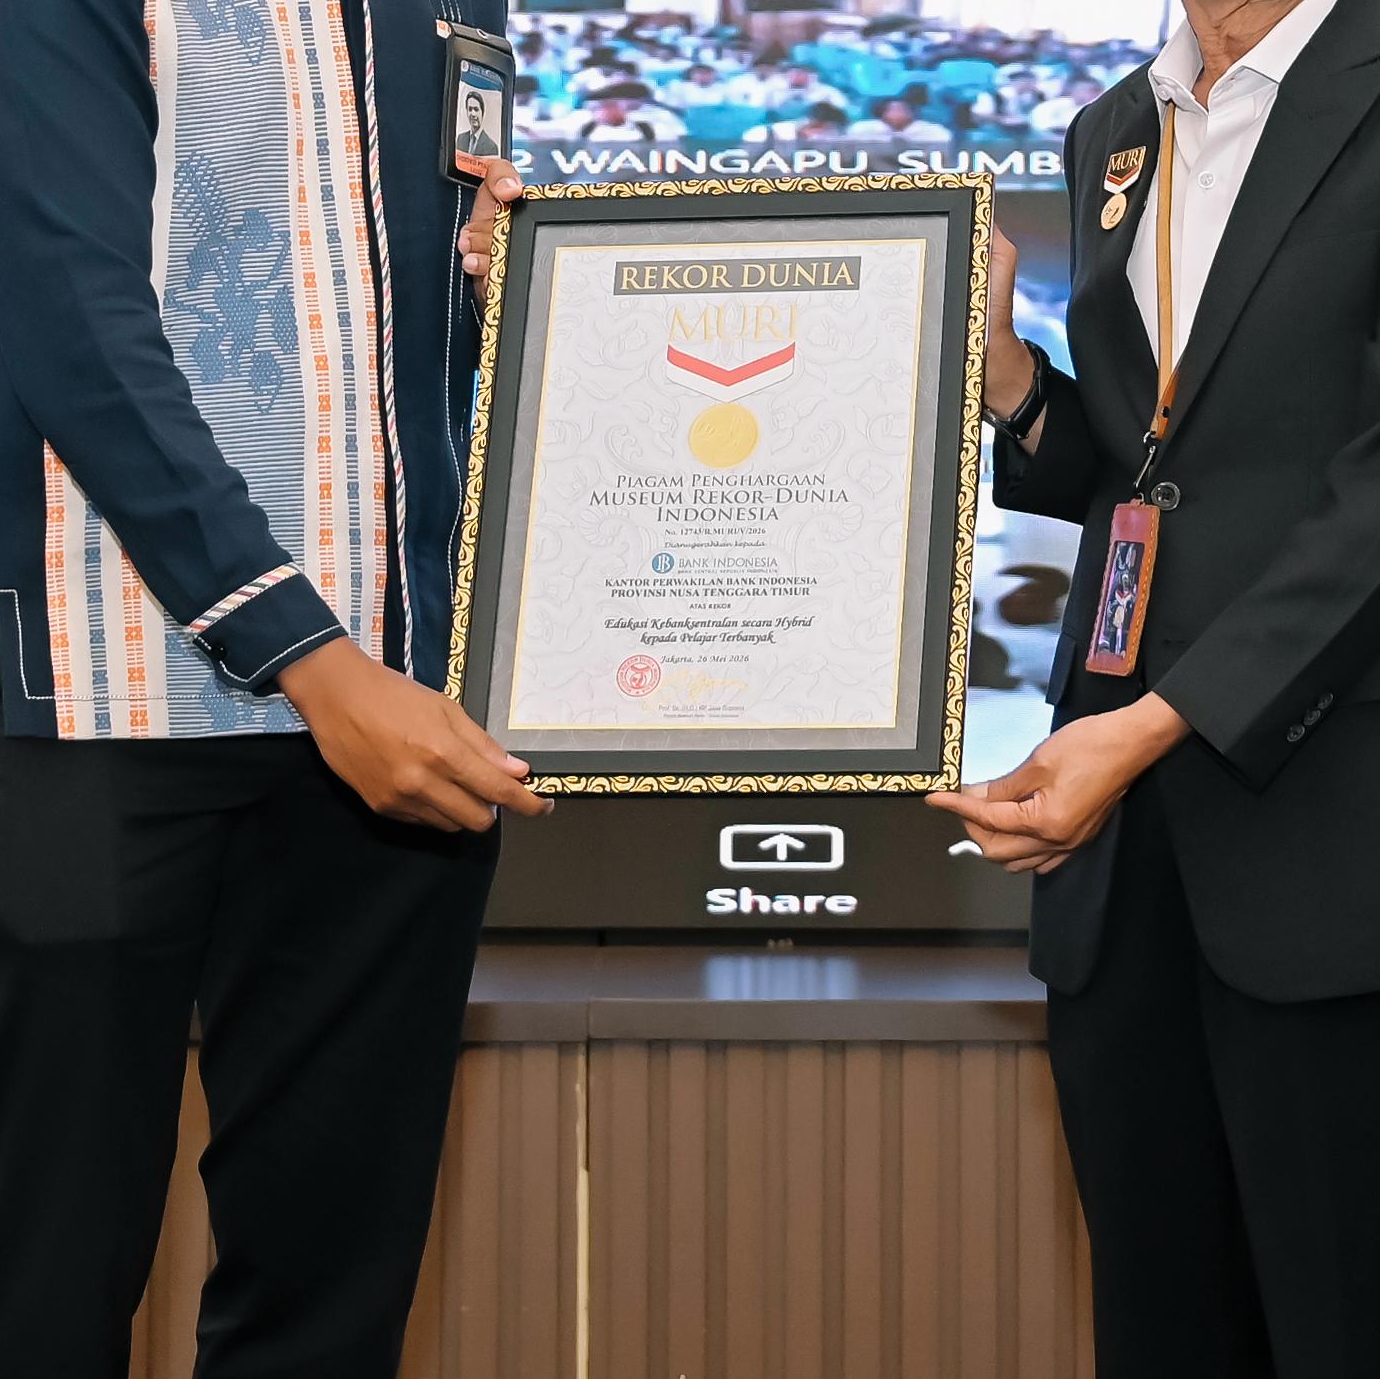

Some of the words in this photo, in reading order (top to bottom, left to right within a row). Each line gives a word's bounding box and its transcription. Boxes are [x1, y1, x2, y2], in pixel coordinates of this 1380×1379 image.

[508, 149, 534, 177] 2
[1111, 149, 1144, 171] MURI
[619, 266, 732, 290] REKOR
[741, 262, 855, 288] DUNIA
[669, 301, 798, 342] MURI
[617, 475, 683, 488] PIAGAM
[691, 473, 825, 487] PENGHARGAAN
[589, 490, 682, 506] MUSEUM
[692, 487, 849, 505] REKOR-DUNIA
[657, 506, 779, 522] INDONESIA
[679, 558, 709, 568] BANK
[713, 557, 778, 567] INDONESIA
[605, 578, 650, 587] KANTOR
[653, 578, 723, 587] PERWAKILAN
[726, 578, 756, 586] BANK
[759, 577, 817, 585] INDONESIA
[611, 588, 667, 598] PROVINSI
[670, 588, 700, 597] NUSA
[703, 588, 767, 597] TENGGARA
[770, 587, 810, 596] TIMUR
[605, 618, 648, 630] Edukasi
[650, 618, 738, 629] Kebanksentralan
[741, 619, 772, 627] secara
[774, 616, 815, 630] Hybrid
[640, 632, 677, 645] kepada
[680, 632, 717, 645] Pelajar
[719, 630, 776, 644] Terbanyak
[709, 655, 726, 663] Mei
[705, 885, 857, 918] Share
